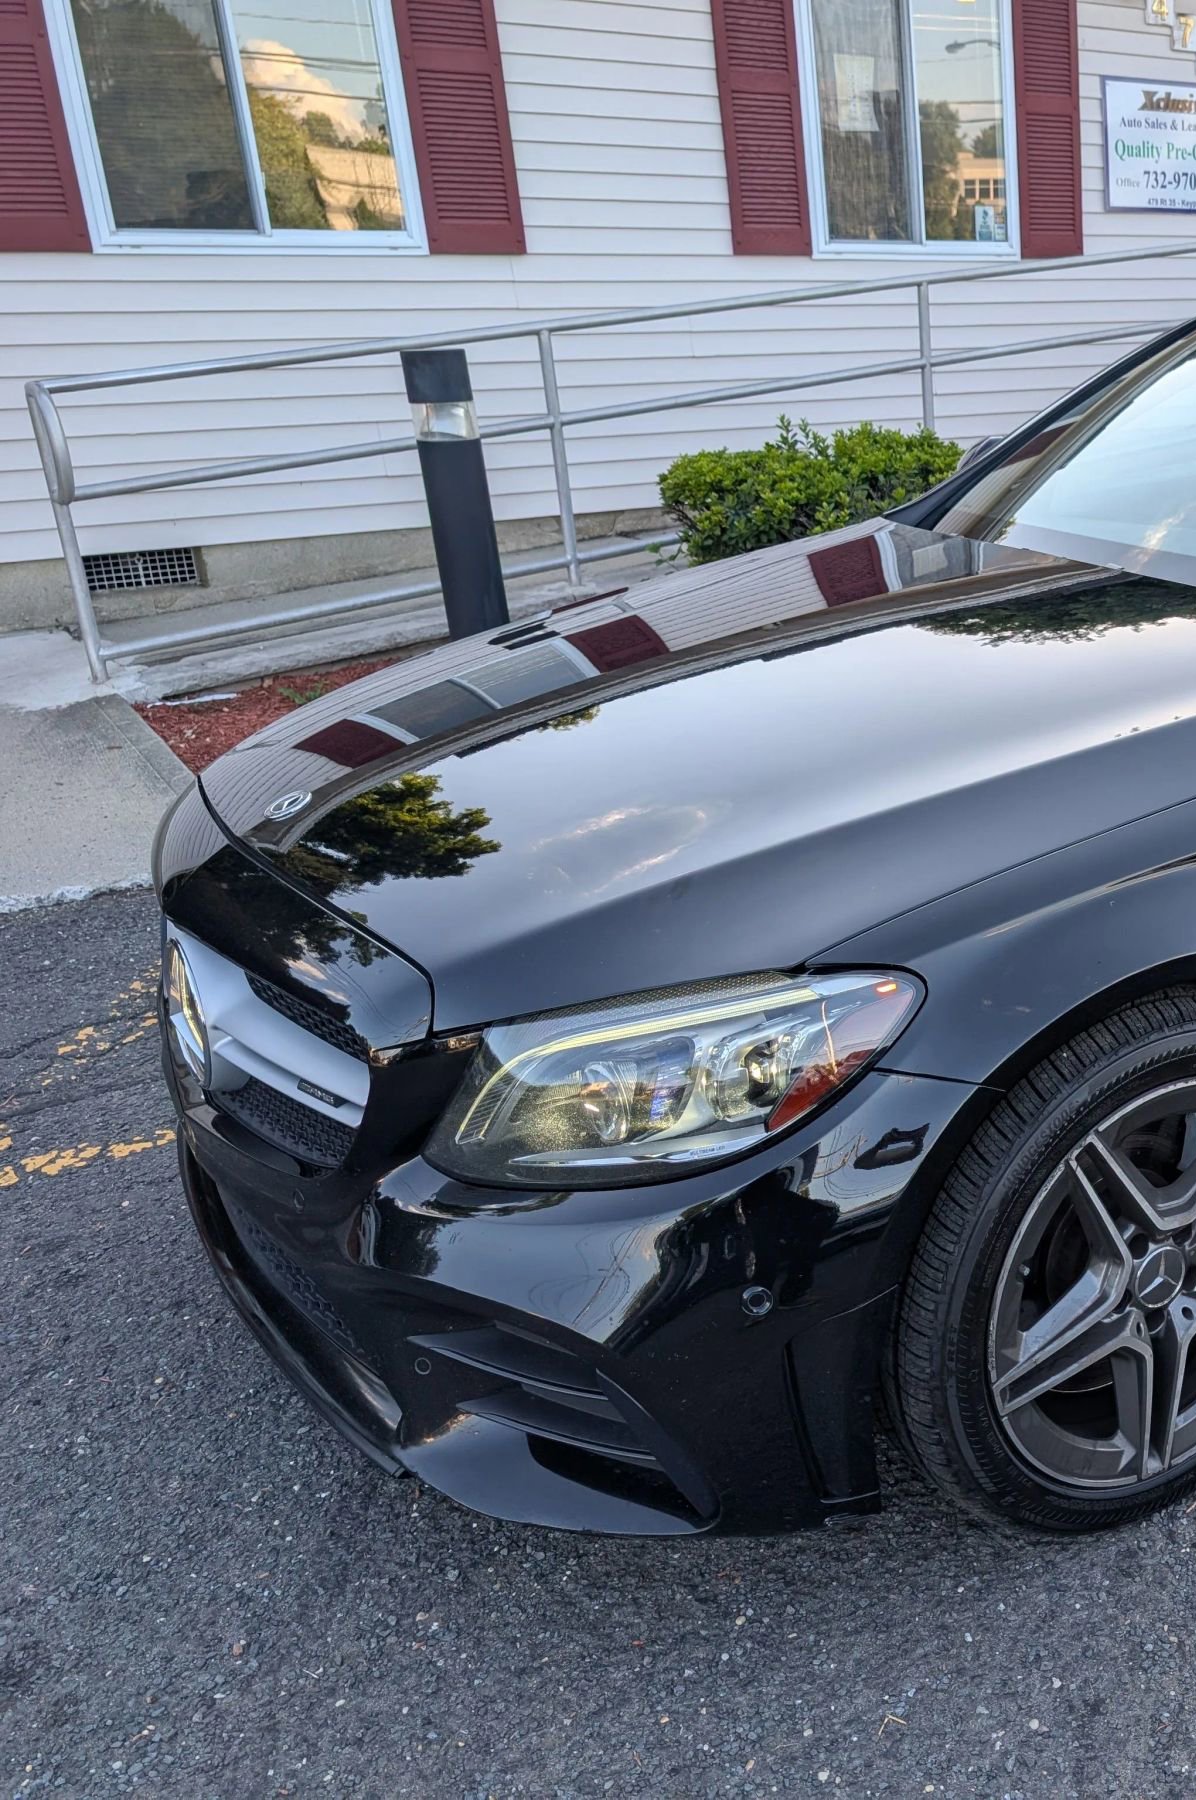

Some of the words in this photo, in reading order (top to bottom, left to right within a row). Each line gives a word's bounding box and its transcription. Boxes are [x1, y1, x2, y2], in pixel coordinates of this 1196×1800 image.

[1119, 117, 1142, 129] Auto
[1144, 118, 1167, 131] Sales
[1169, 120, 1178, 131] &
[1114, 138, 1162, 164] Quality
[1115, 177, 1141, 188] Office
